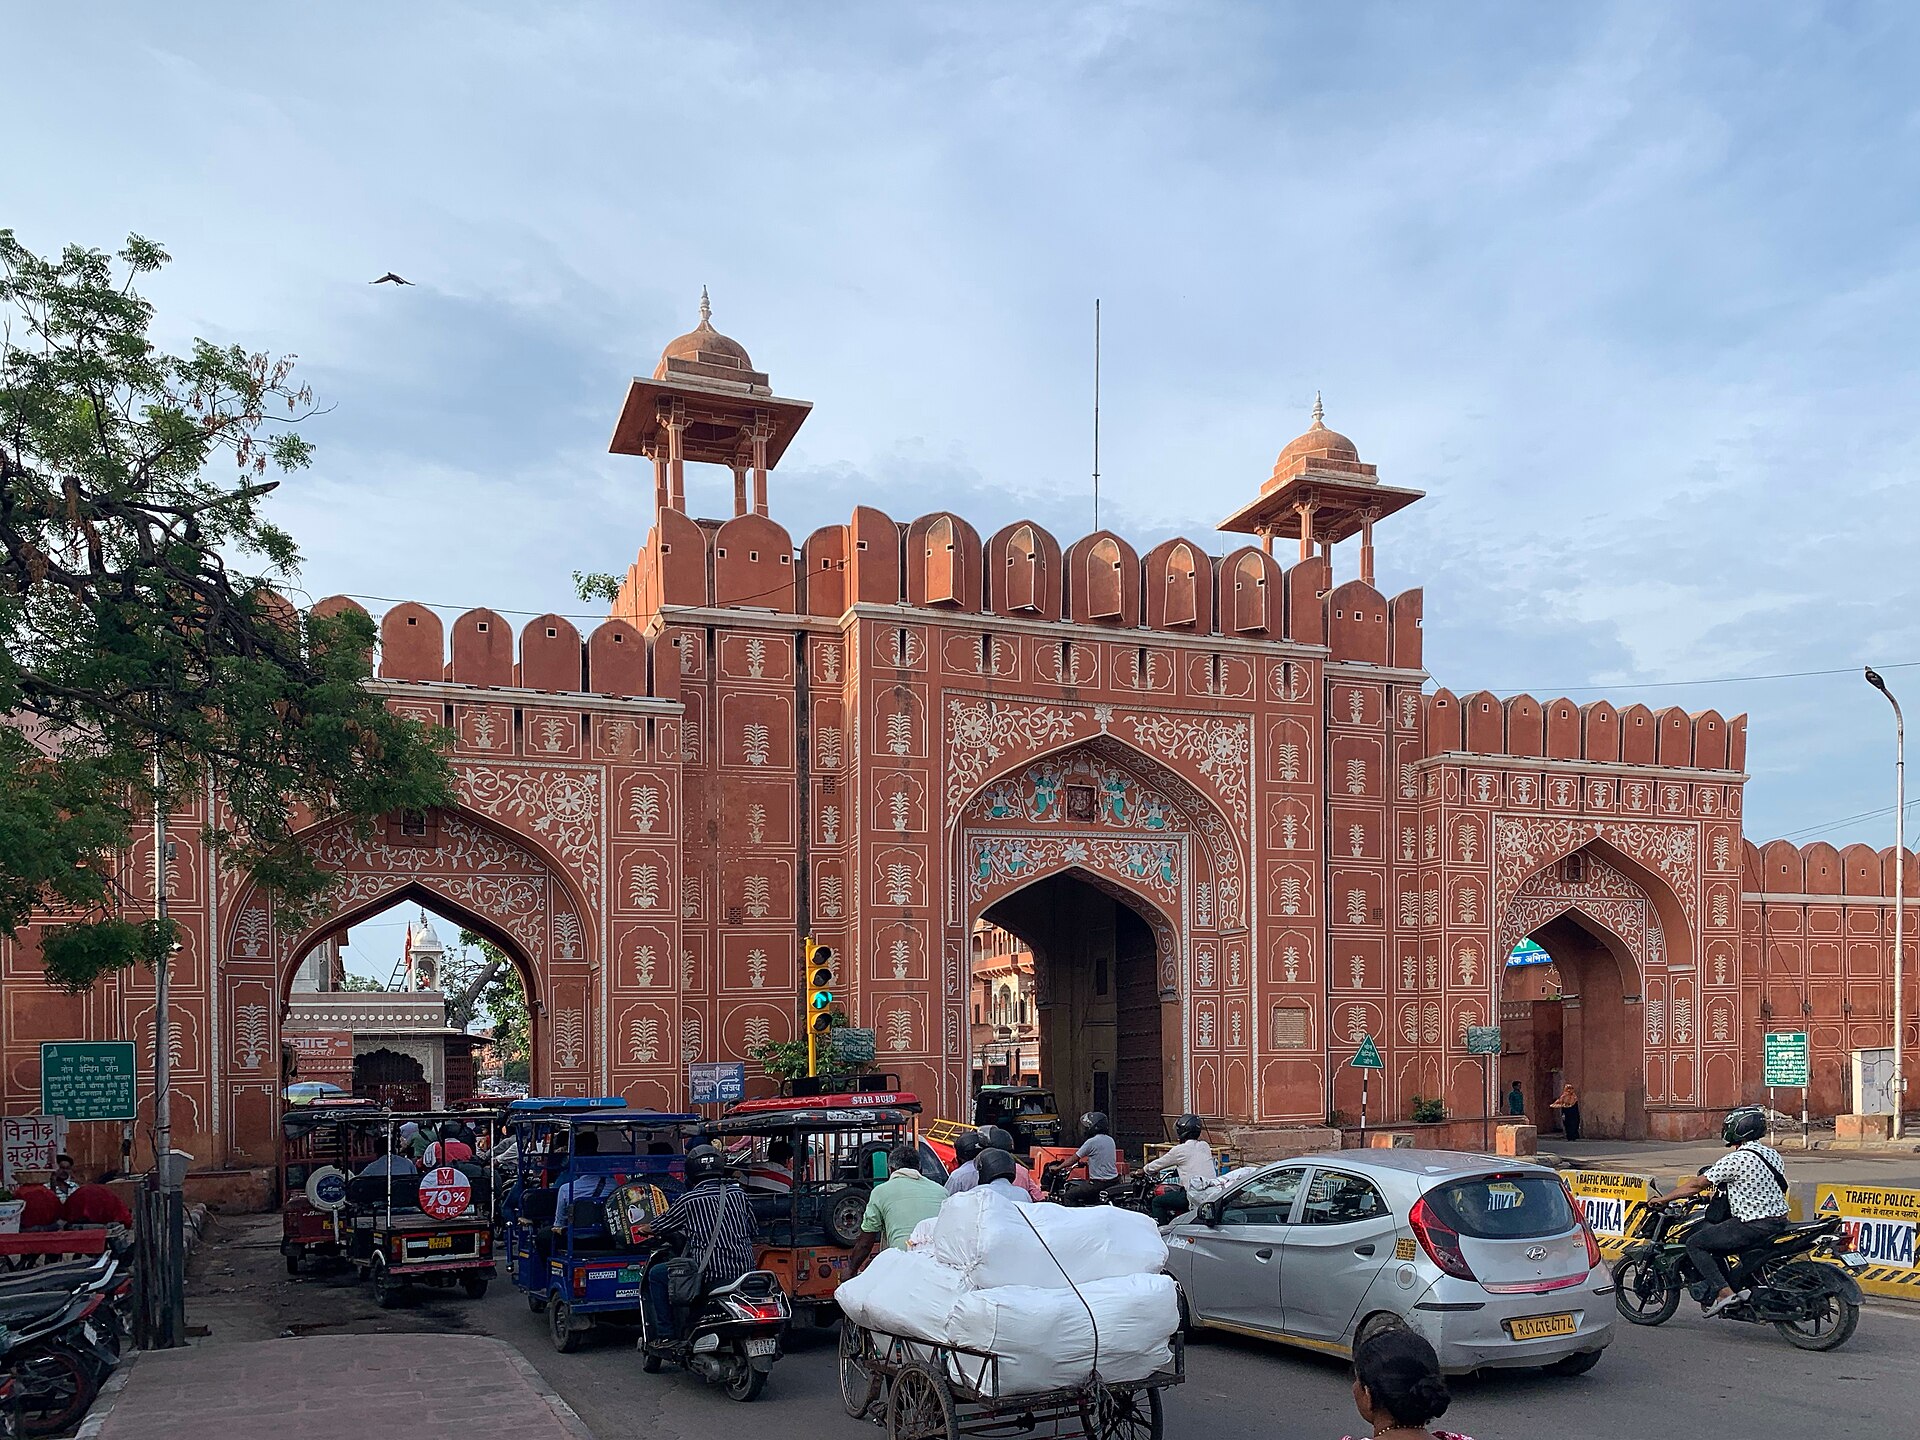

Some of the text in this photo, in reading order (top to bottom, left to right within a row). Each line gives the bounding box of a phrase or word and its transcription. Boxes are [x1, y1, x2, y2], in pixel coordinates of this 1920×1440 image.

[721, 1082, 740, 1093] संजय
[851, 1096, 874, 1105] STAR
[4, 1117, 53, 1140] विनोद
[441, 1169, 450, 1180] V
[1576, 1174, 1644, 1189] TRAFFIC POLICE JAIPUR
[425, 1190, 466, 1207] 70%
[1845, 1190, 1916, 1208] TRAFFIC POLICE
[436, 1205, 446, 1214] की
[1166, 1233, 1190, 1249] Uber
[1844, 1221, 1913, 1262] MOJIKA
[1517, 1317, 1574, 1336] RJ14TE4774
